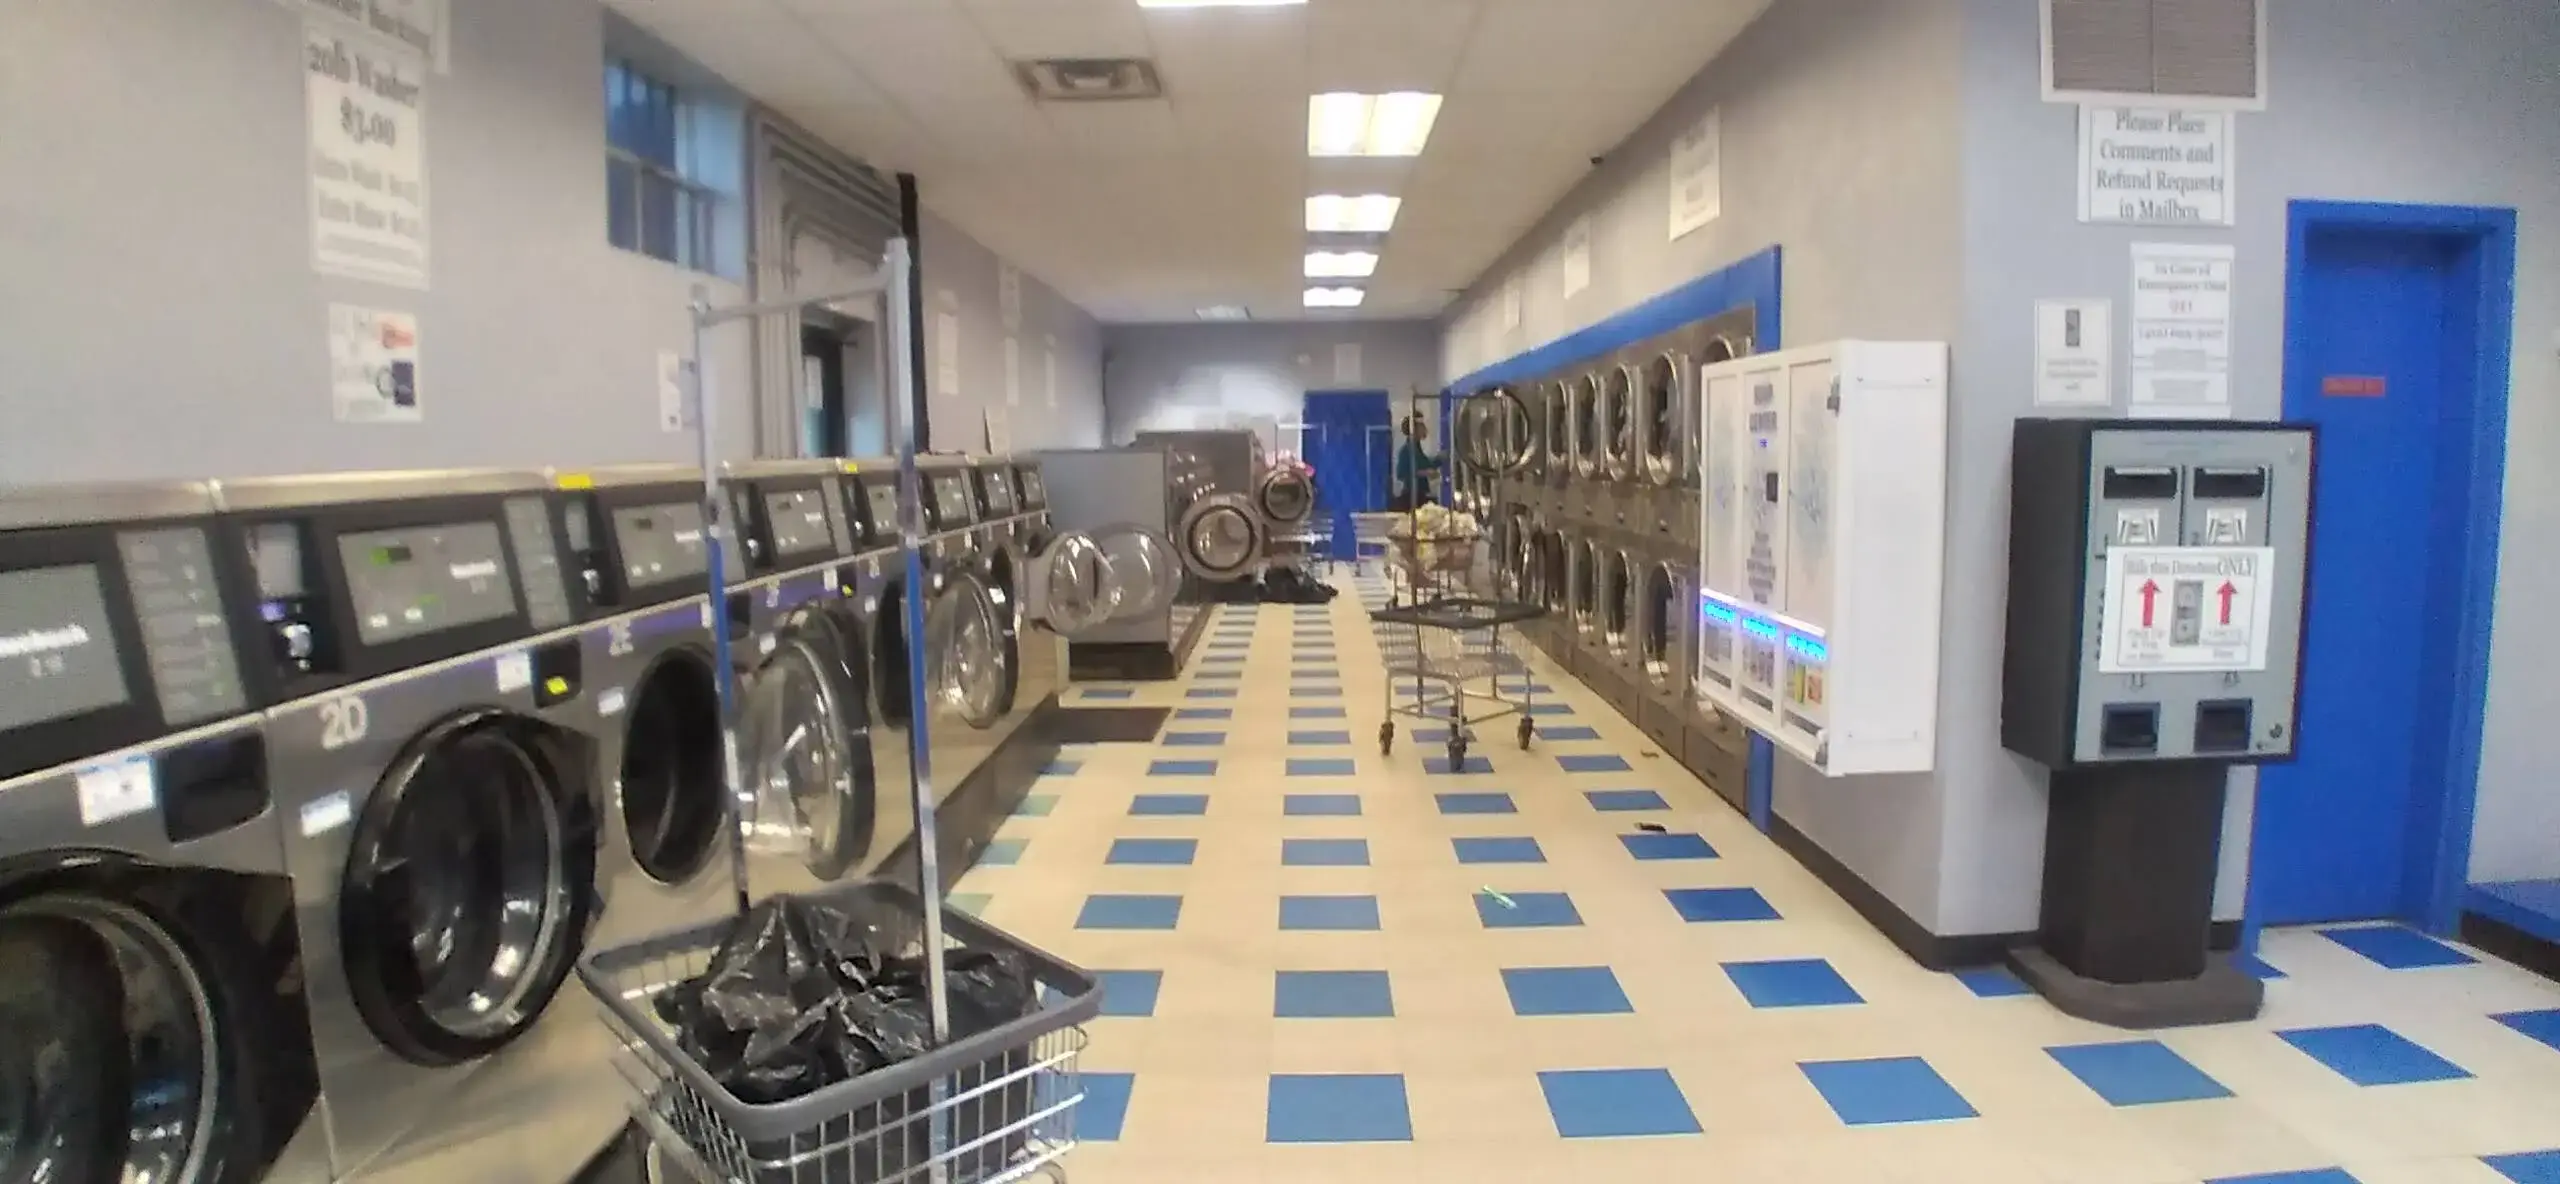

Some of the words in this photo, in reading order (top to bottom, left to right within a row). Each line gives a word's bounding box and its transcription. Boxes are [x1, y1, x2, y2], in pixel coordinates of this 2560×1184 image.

[2115, 107, 2163, 131] Please
[2167, 110, 2206, 133] Place
[2100, 138, 2182, 162] Comments
[2186, 142, 2214, 164] and
[2096, 168, 2151, 190] Refund
[2156, 171, 2224, 197] Requests
[2119, 197, 2134, 219] in
[2139, 197, 2200, 221] Mailbox
[2218, 555, 2253, 577] ONLY
